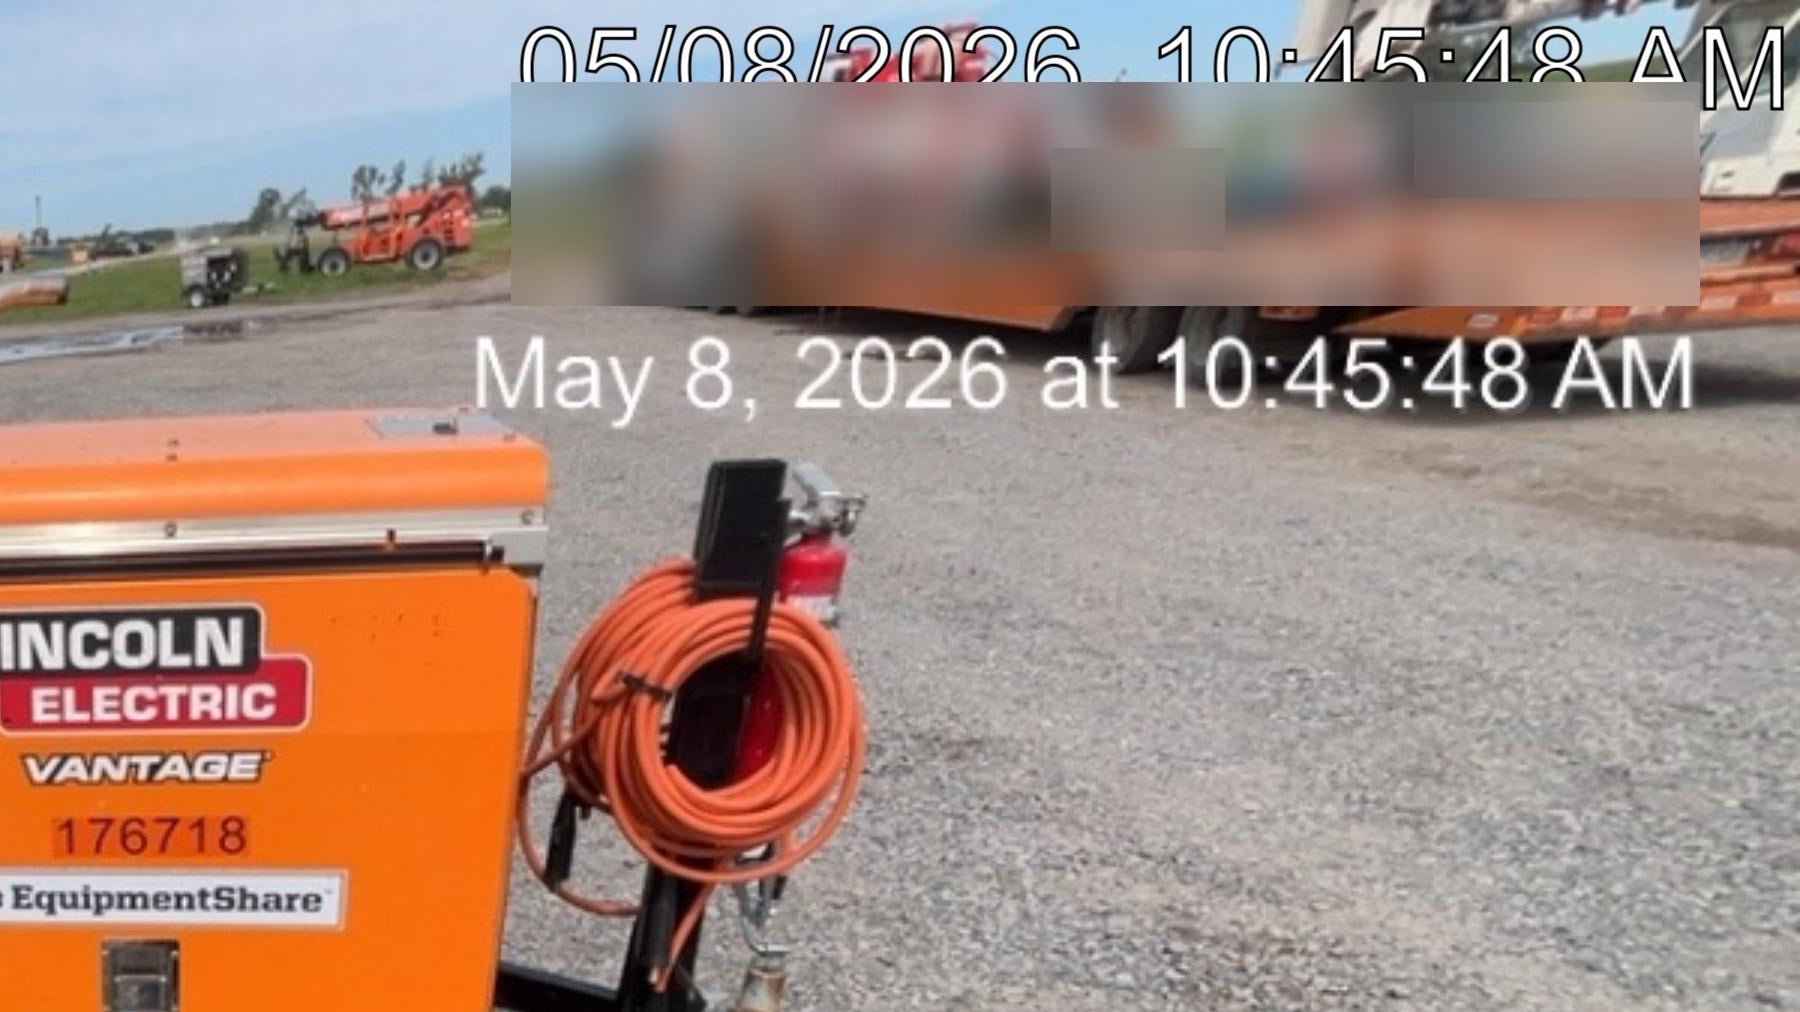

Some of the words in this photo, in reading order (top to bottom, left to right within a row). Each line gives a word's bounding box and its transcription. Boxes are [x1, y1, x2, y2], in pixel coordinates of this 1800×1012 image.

[31, 682, 277, 723] ELECTRIC
[22, 753, 266, 785] VANTAGE
[56, 816, 248, 856] 176718
[11, 884, 323, 916] EquipmentShare
